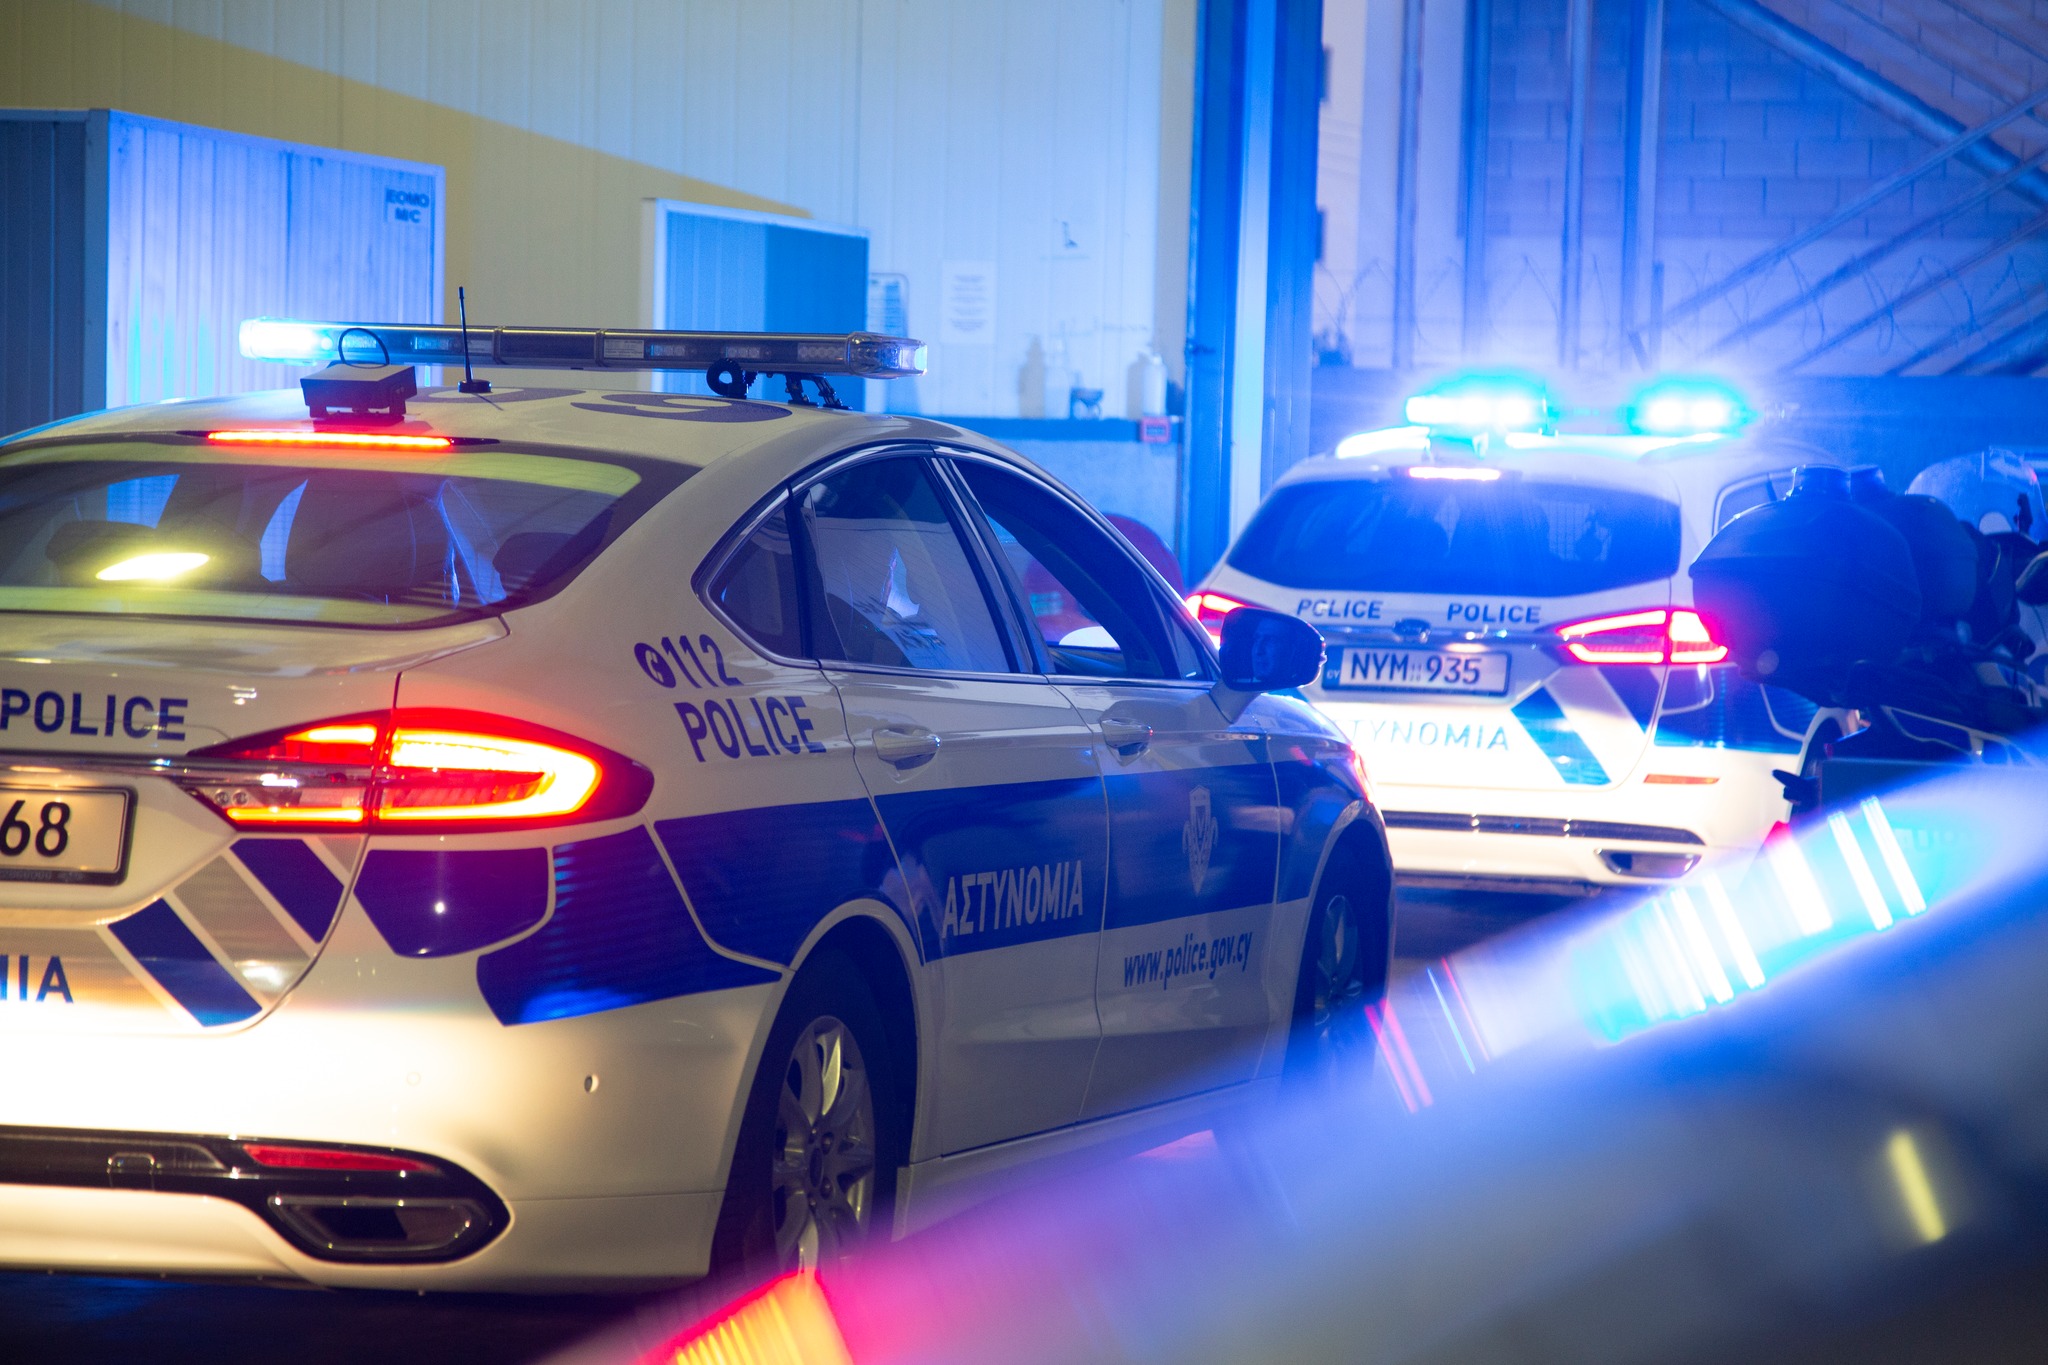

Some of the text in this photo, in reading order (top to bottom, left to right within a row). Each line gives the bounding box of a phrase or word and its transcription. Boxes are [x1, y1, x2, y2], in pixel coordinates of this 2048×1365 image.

[1446, 602, 1542, 624] POLICE
[661, 634, 744, 689] 112
[1350, 651, 1408, 682] NYM
[1426, 655, 1482, 685] 935
[0, 688, 188, 741] POLICE
[673, 695, 827, 762] POLICE
[0, 799, 71, 857] 68
[941, 860, 1084, 940] ΑΣΤΥΝΟΜΙΑ
[1124, 932, 1253, 991] www.police.gov.cy
